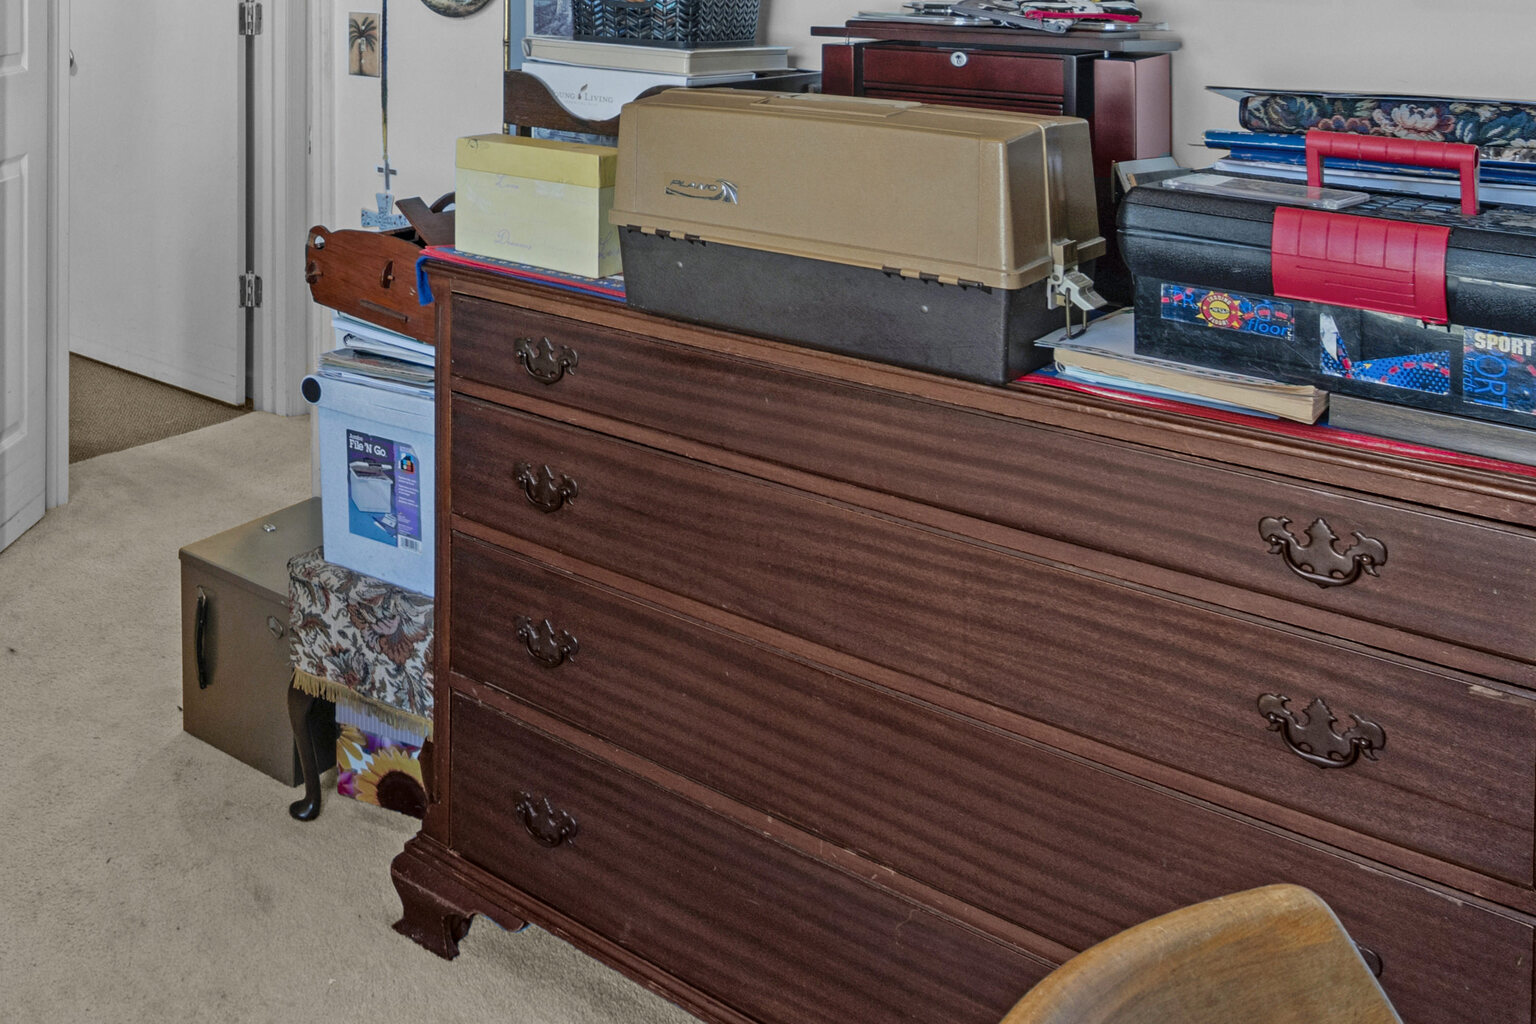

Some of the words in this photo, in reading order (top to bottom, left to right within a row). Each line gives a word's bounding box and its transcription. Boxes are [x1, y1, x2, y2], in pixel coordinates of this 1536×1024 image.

[554, 91, 575, 100] OUNG
[670, 179, 718, 192] PLANO
[1474, 331, 1535, 356] SPORT
[349, 439, 364, 452] File
[373, 446, 386, 457] Go
